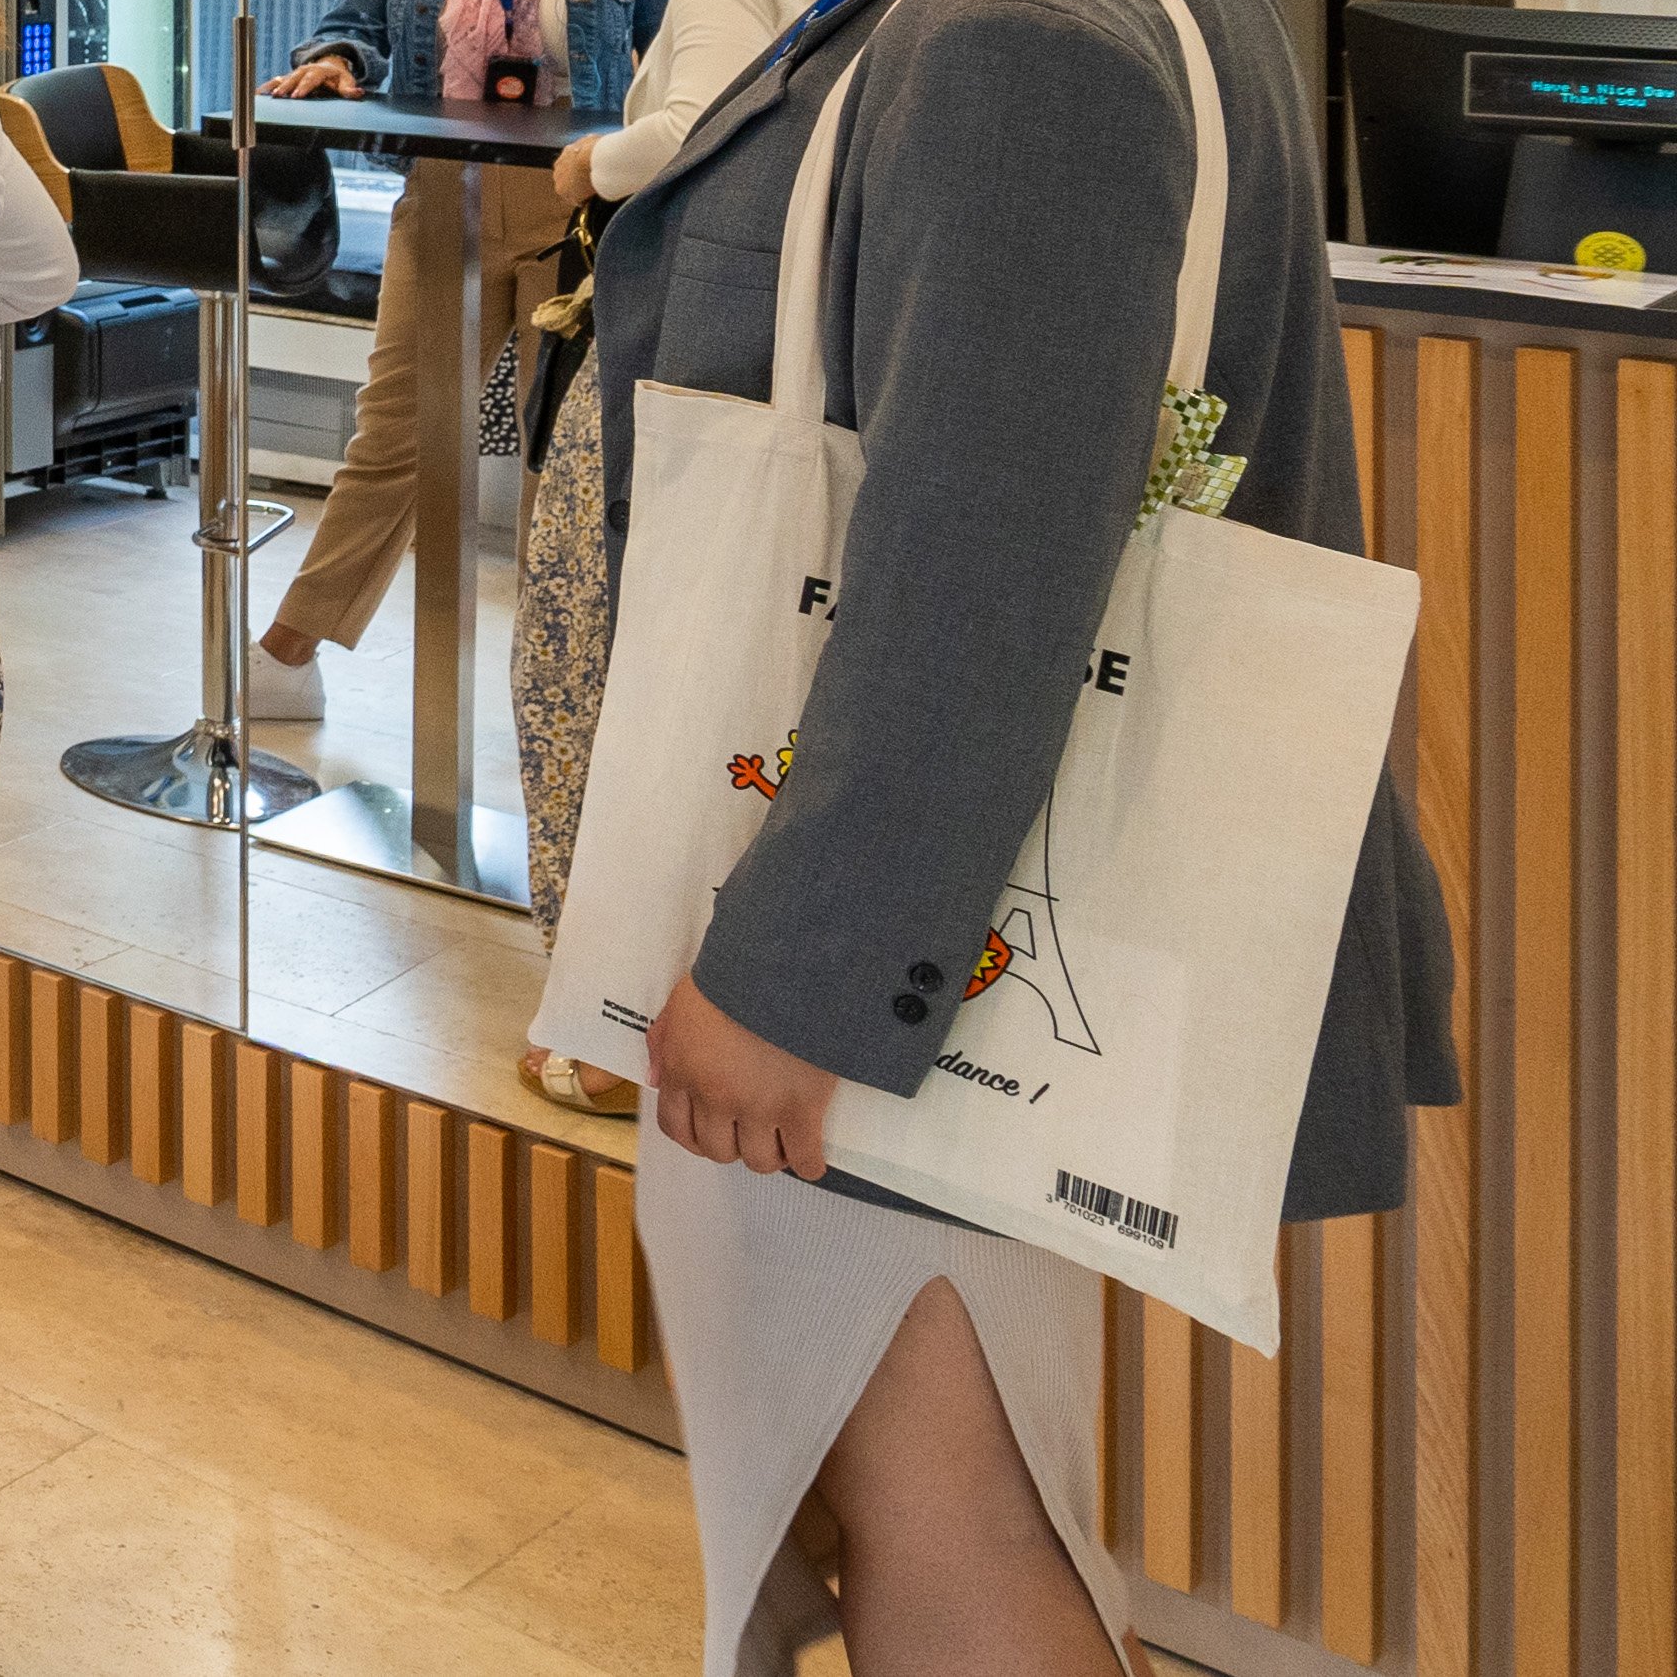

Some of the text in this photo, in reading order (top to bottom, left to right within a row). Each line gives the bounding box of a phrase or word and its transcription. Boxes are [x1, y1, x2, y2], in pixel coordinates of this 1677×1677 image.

[1596, 84, 1637, 95] Nice
[1560, 93, 1608, 105] Thank
[1046, 1193, 1164, 1250] 3 701023 699109
